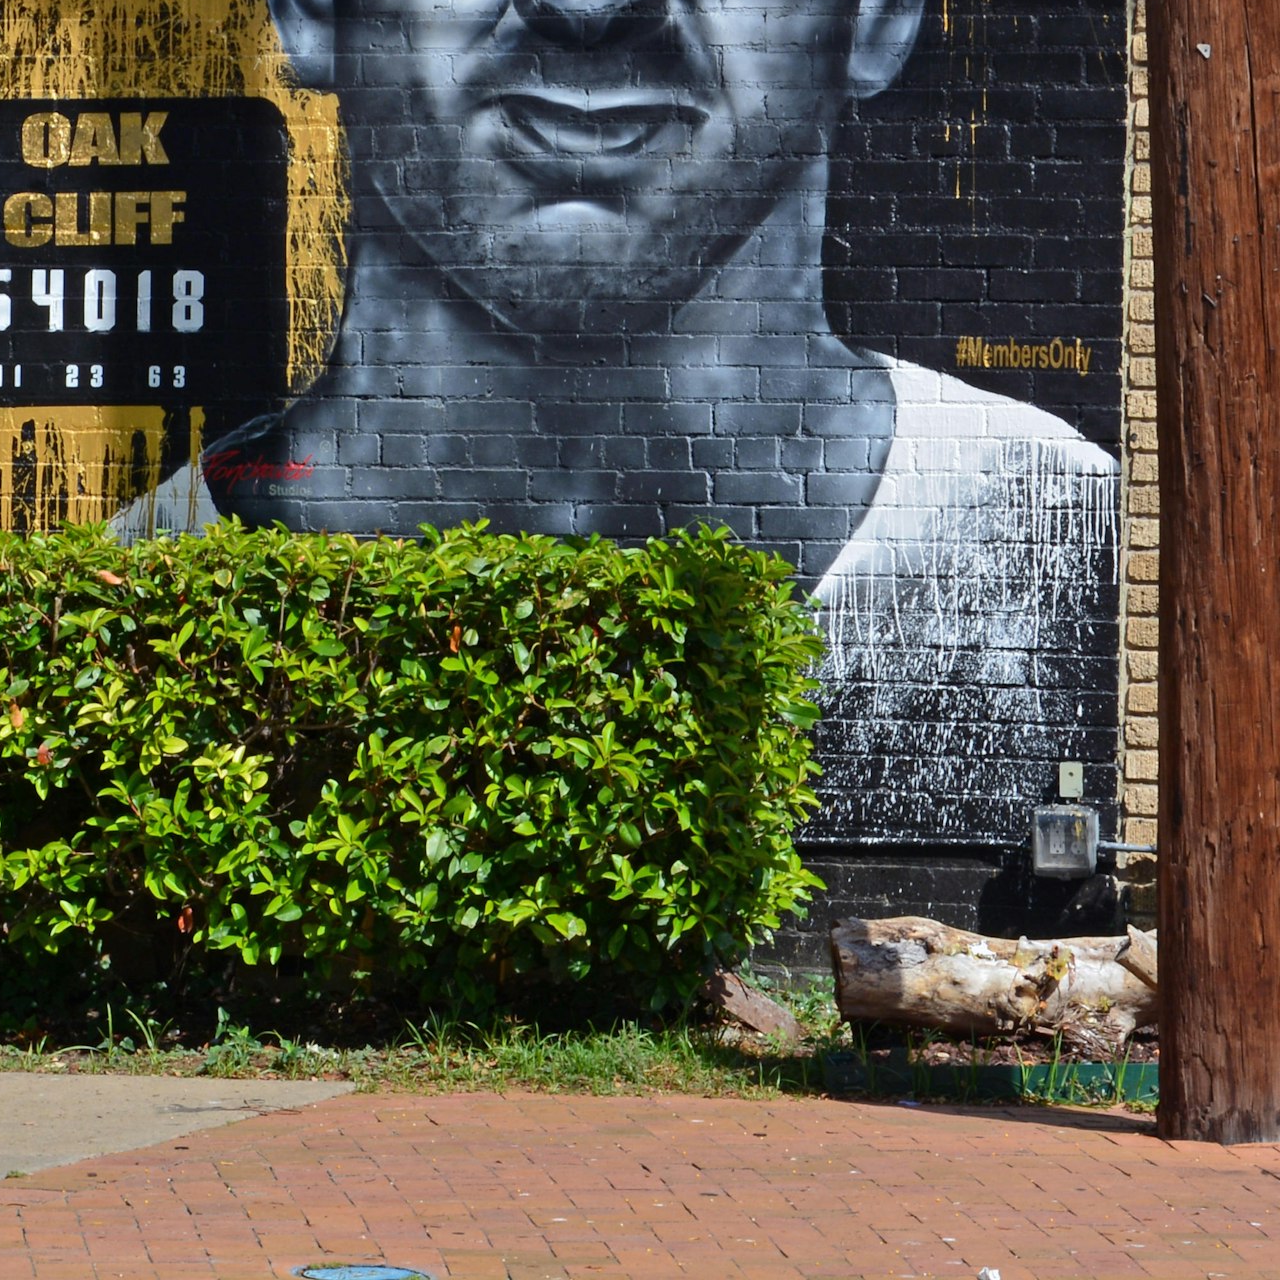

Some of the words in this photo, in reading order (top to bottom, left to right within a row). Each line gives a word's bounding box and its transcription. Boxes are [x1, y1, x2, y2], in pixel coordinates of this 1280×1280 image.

[21, 111, 170, 168] OAK
[3, 190, 188, 248] CLIFF
[65, 364, 104, 388] 23
[148, 364, 187, 388] 63
[955, 335, 1092, 376] #MembersOnly
[268, 483, 314, 497] Studios
